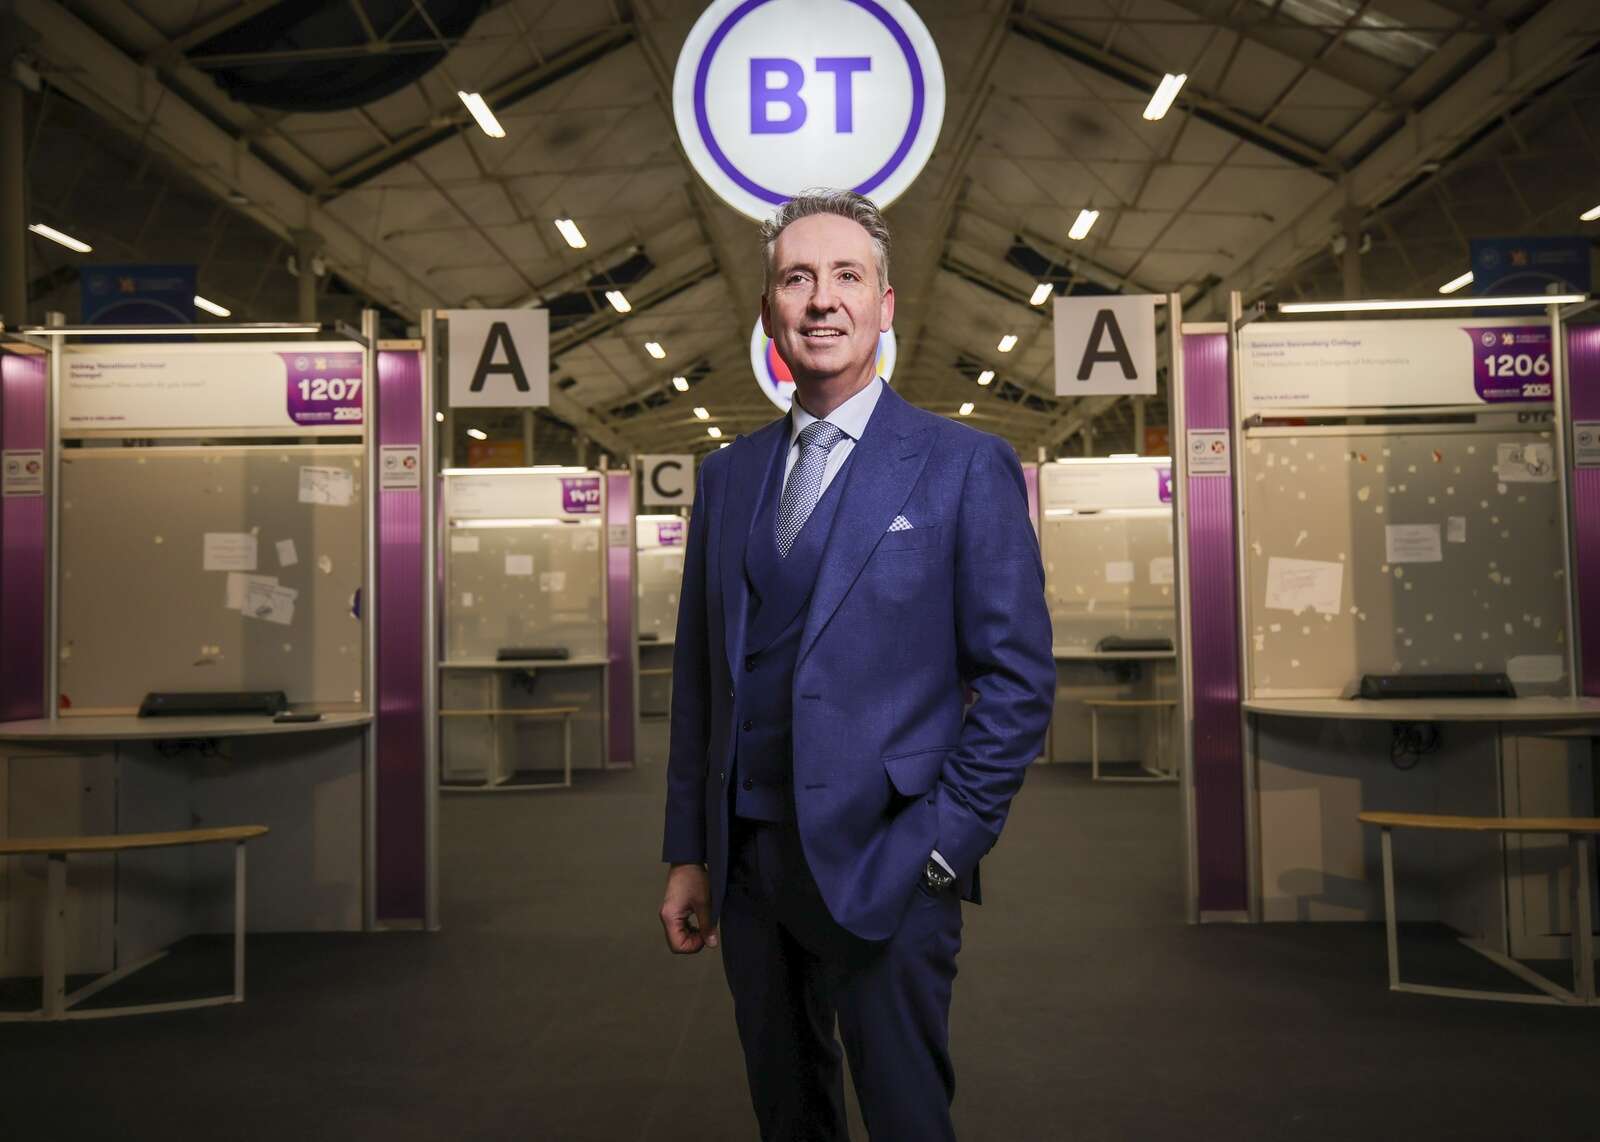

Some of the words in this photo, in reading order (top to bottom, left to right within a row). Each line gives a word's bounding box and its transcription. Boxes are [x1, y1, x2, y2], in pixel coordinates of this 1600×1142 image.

[750, 57, 871, 134] BT
[470, 321, 530, 392] A
[1076, 308, 1138, 381] A
[1484, 354, 1550, 377] 1206
[298, 378, 361, 401] 1207
[651, 461, 683, 498] C
